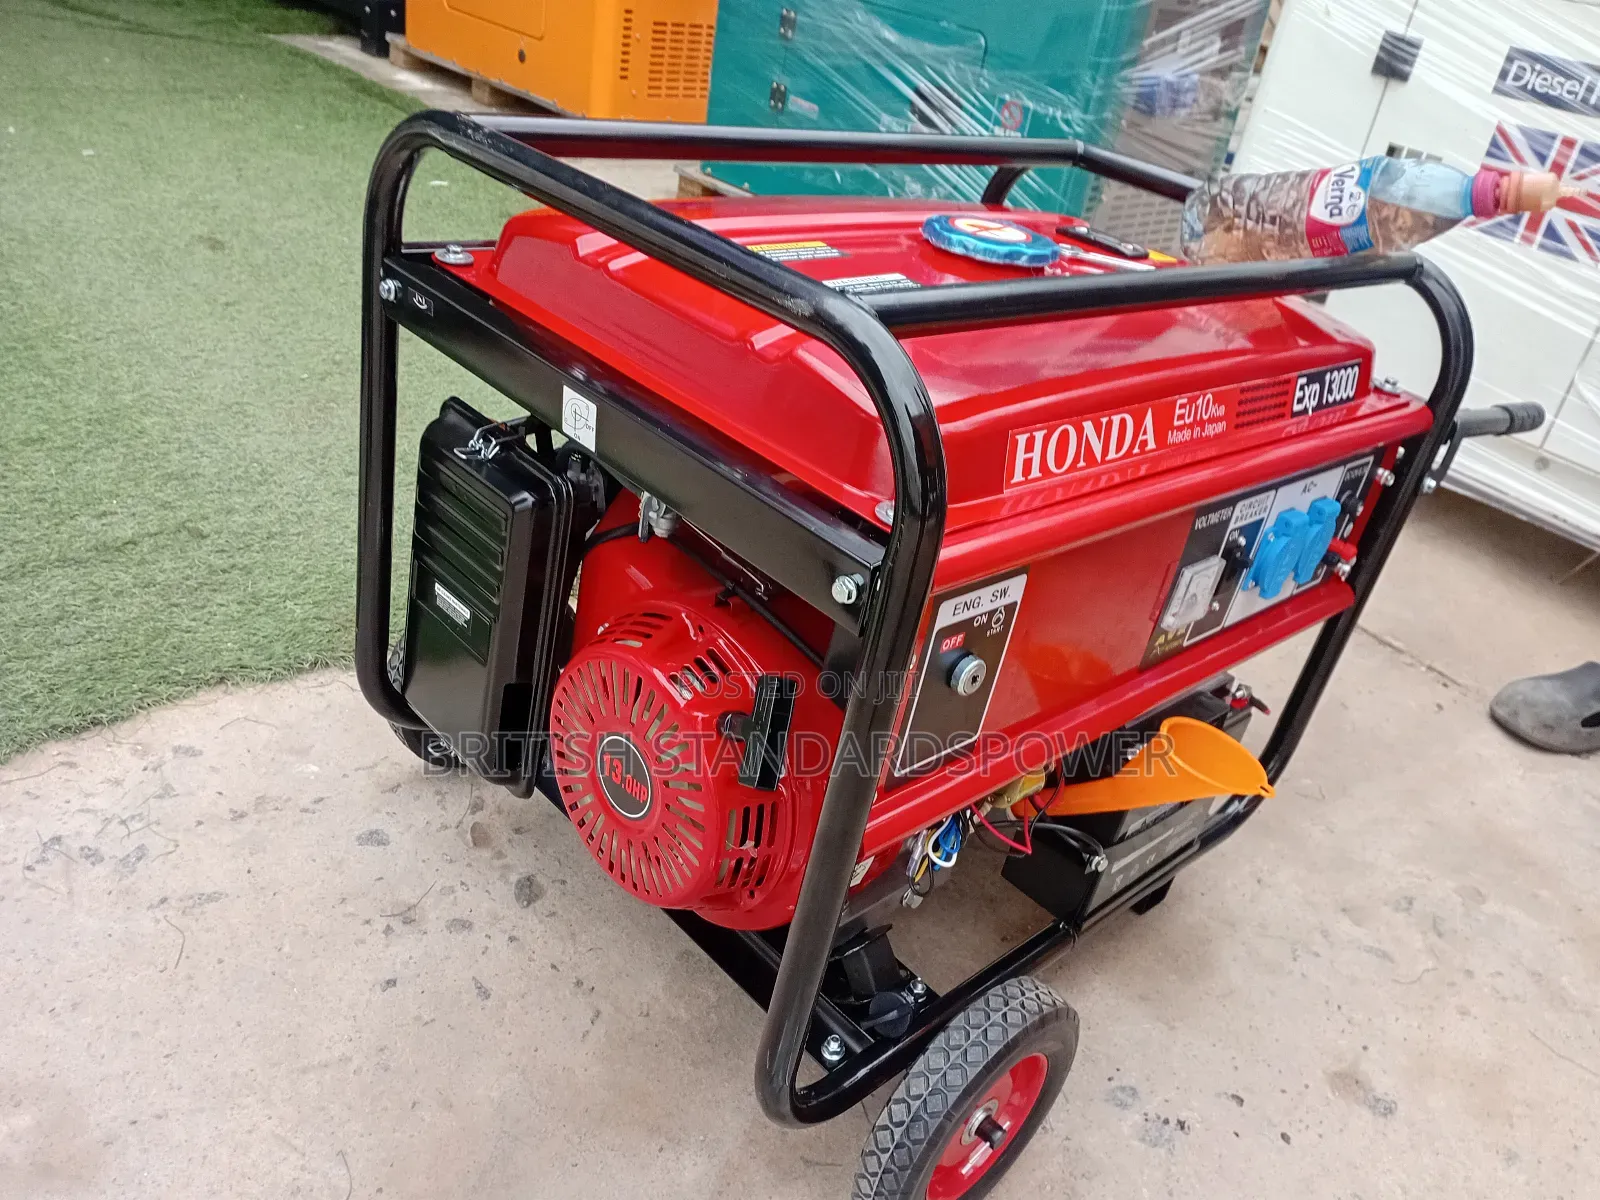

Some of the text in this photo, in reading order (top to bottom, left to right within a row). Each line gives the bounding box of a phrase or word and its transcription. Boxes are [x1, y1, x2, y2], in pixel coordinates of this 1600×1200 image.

[1506, 60, 1591, 101] Diesel
[1325, 166, 1355, 219] Verna
[1292, 365, 1359, 416] Exp 13000
[1167, 420, 1227, 445] Made in Japan
[1010, 407, 1157, 484] HONDA
[1234, 505, 1268, 525] BREAKER
[1240, 494, 1270, 514] CIRCUIT
[1194, 506, 1233, 531] VOLTMETER
[952, 585, 1011, 616] ENG. SW.
[973, 613, 988, 627] ON
[986, 625, 1004, 637] START
[942, 633, 964, 650] OFF
[603, 753, 648, 803] 13.0HP
